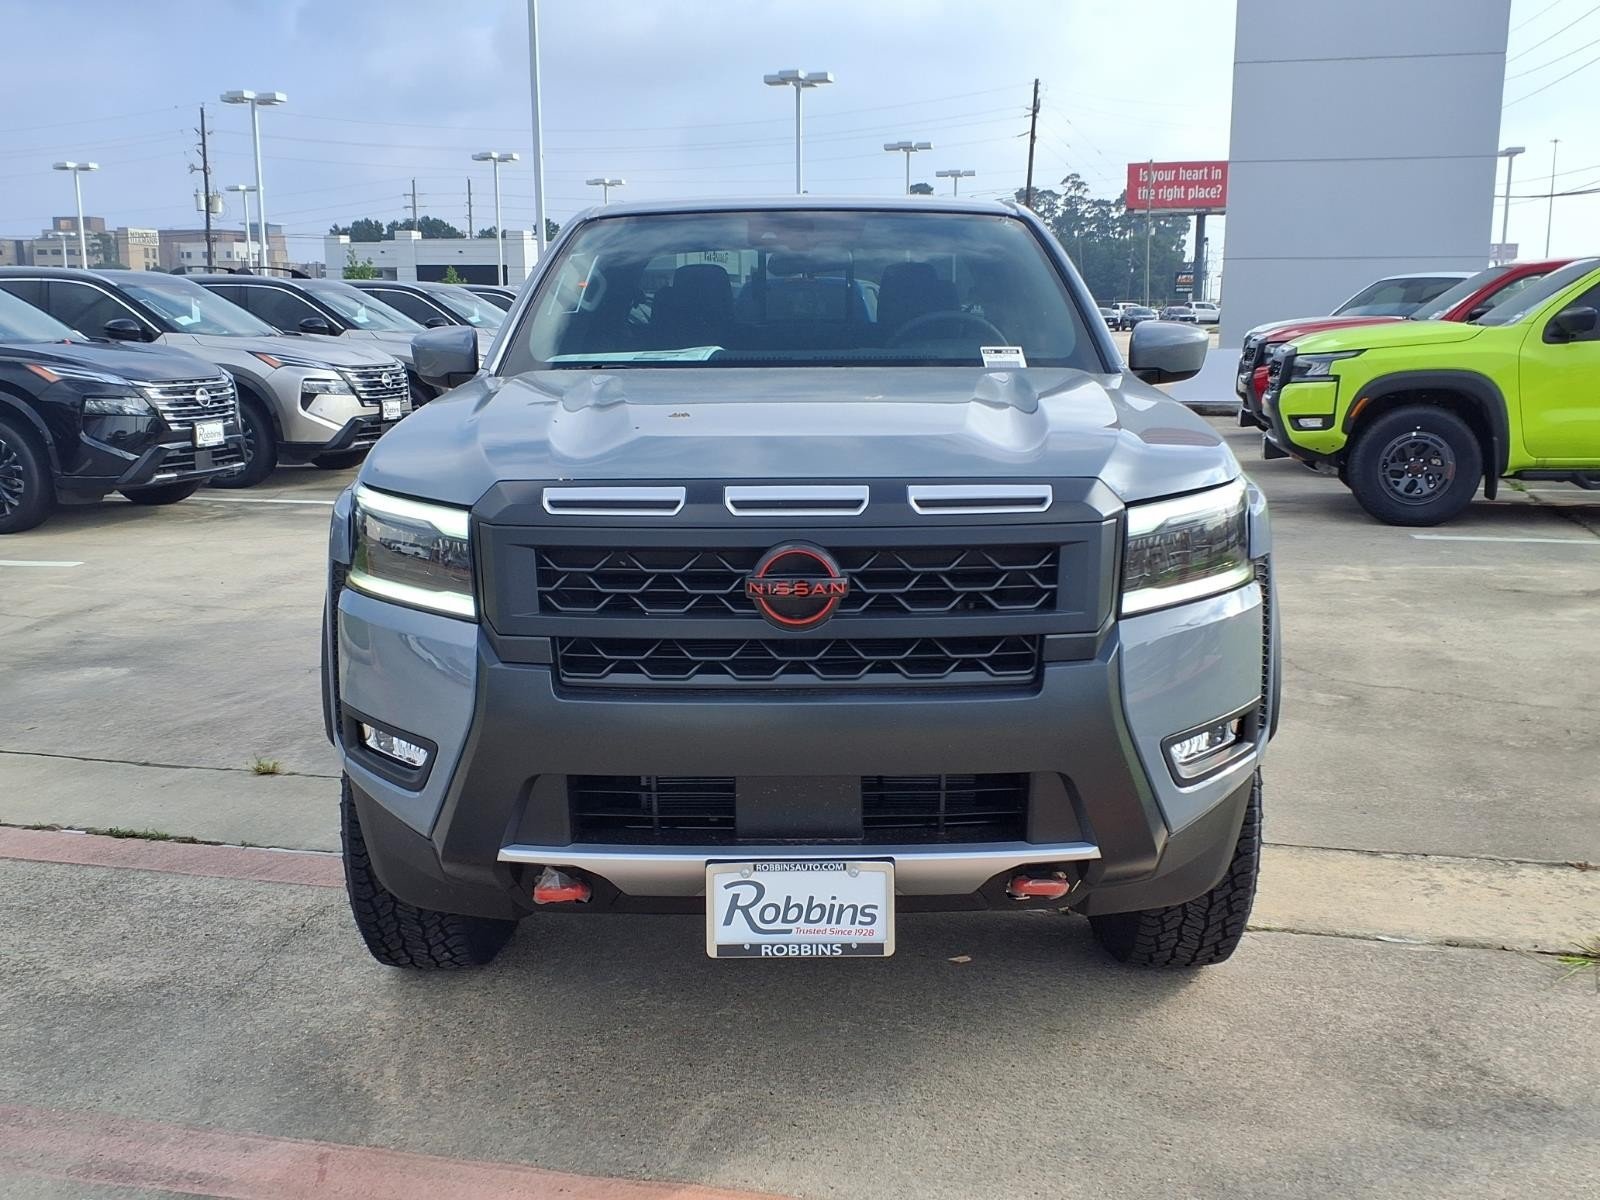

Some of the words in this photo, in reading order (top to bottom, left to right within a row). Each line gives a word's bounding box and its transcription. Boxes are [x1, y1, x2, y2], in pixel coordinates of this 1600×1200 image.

[1139, 168, 1148, 182] Is
[1151, 169, 1176, 184] your
[1179, 166, 1208, 181] heart
[1212, 166, 1222, 179] in
[1138, 186, 1156, 200] the
[1158, 185, 1185, 201] right
[1188, 184, 1223, 200] place?
[749, 582, 844, 595] NISSAN
[756, 863, 844, 872] ROBBINSAUTO.COM
[723, 880, 878, 935] Robbins
[795, 927, 827, 935] Trusted
[828, 927, 853, 936] Since
[854, 928, 875, 936] 1928
[761, 944, 843, 956] ROBBINS
